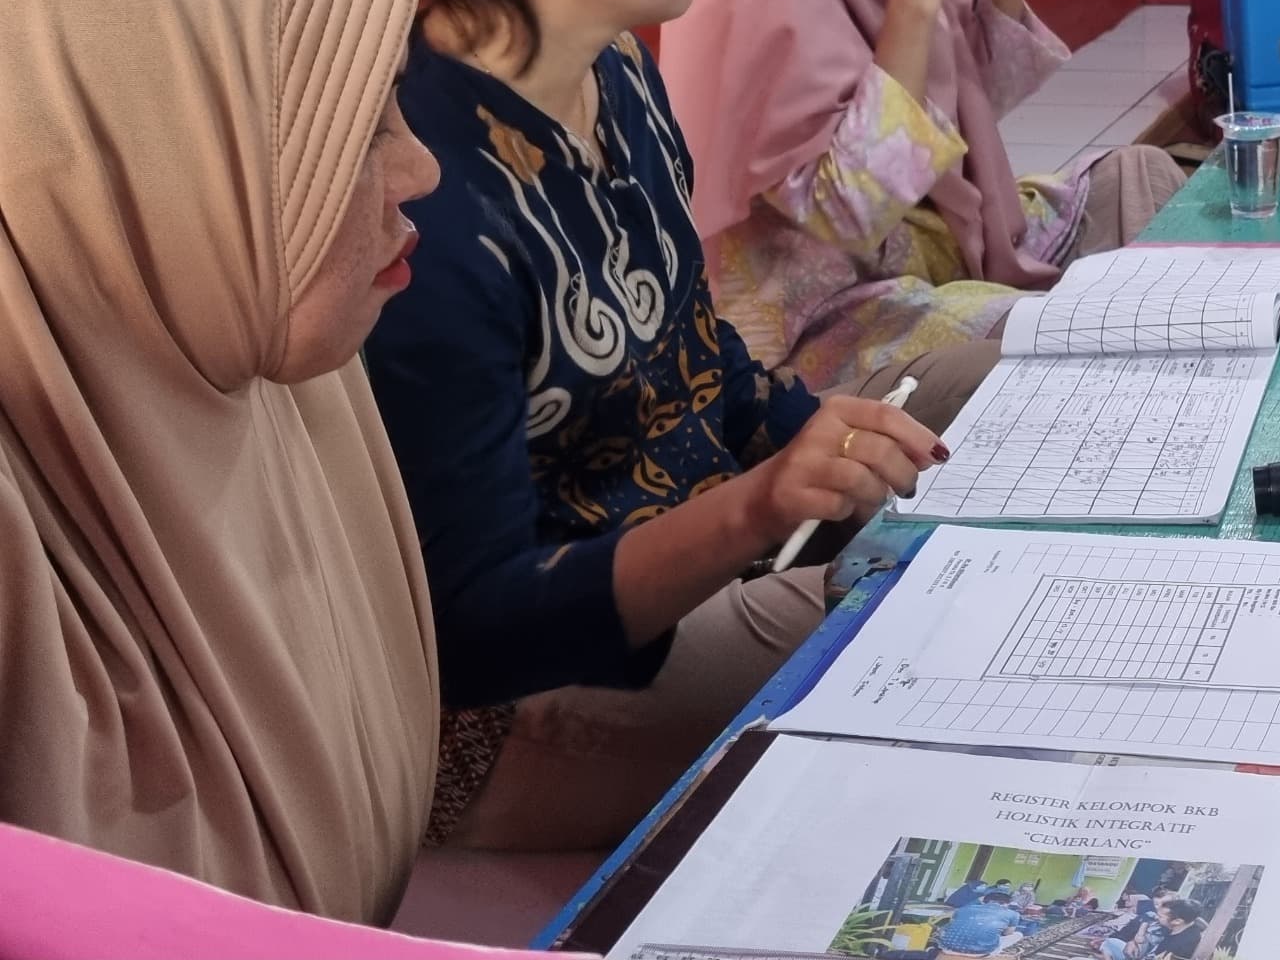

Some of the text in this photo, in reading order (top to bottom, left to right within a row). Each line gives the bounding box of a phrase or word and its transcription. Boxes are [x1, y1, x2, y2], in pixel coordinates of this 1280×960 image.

[990, 792, 1219, 817] REGISTER KELOMPOK BKB
[995, 810, 1196, 834] HOLISTIK INTEGRATIF
